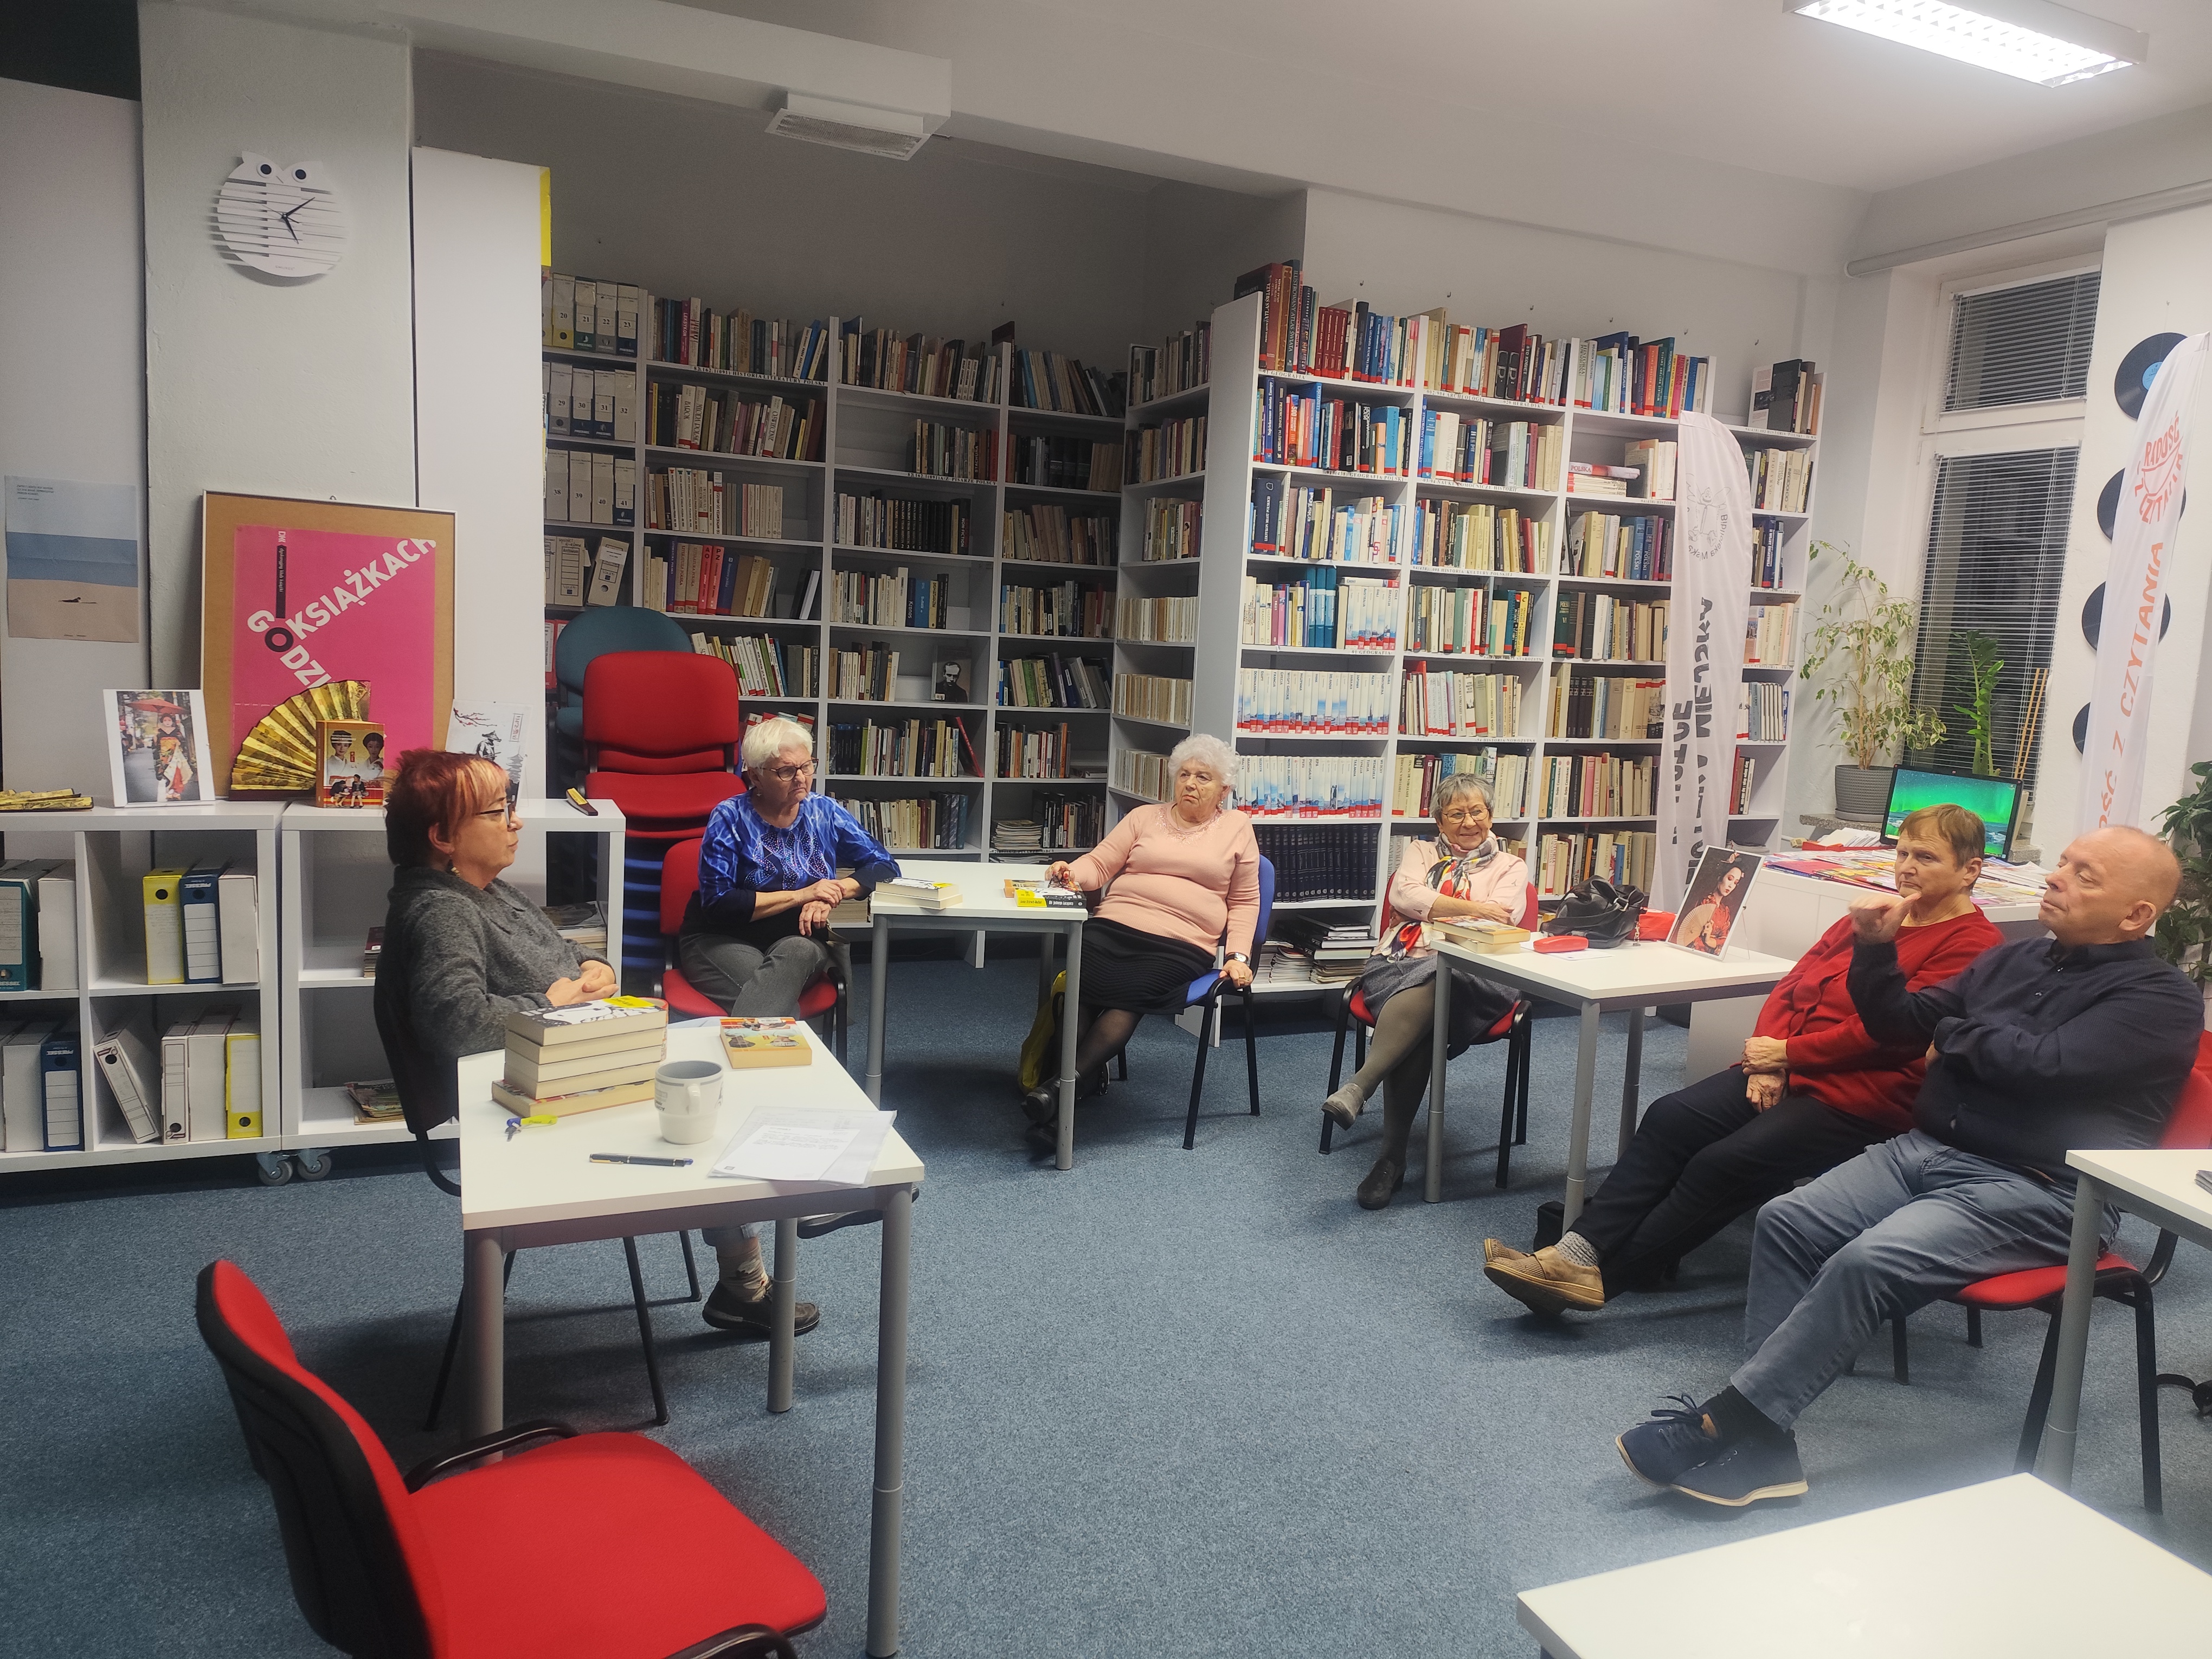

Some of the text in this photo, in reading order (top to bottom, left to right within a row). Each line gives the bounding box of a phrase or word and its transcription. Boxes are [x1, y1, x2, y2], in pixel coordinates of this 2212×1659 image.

[1291, 270, 1299, 311] ILUSTROWANY
[763, 374, 800, 382] LITERATURY
[1271, 370, 1305, 380] GEOGRAFIA
[1447, 393, 1485, 402] ARCHEOLOGIA
[683, 402, 691, 420] BAROK
[2143, 410, 2181, 469] RADOŚĆ
[1349, 472, 1381, 480] GEOGRAFIA
[1570, 465, 1592, 473] POLSKA
[285, 538, 436, 640] KSIĄŻKACH
[2113, 542, 2163, 757] Z CZYTANIA
